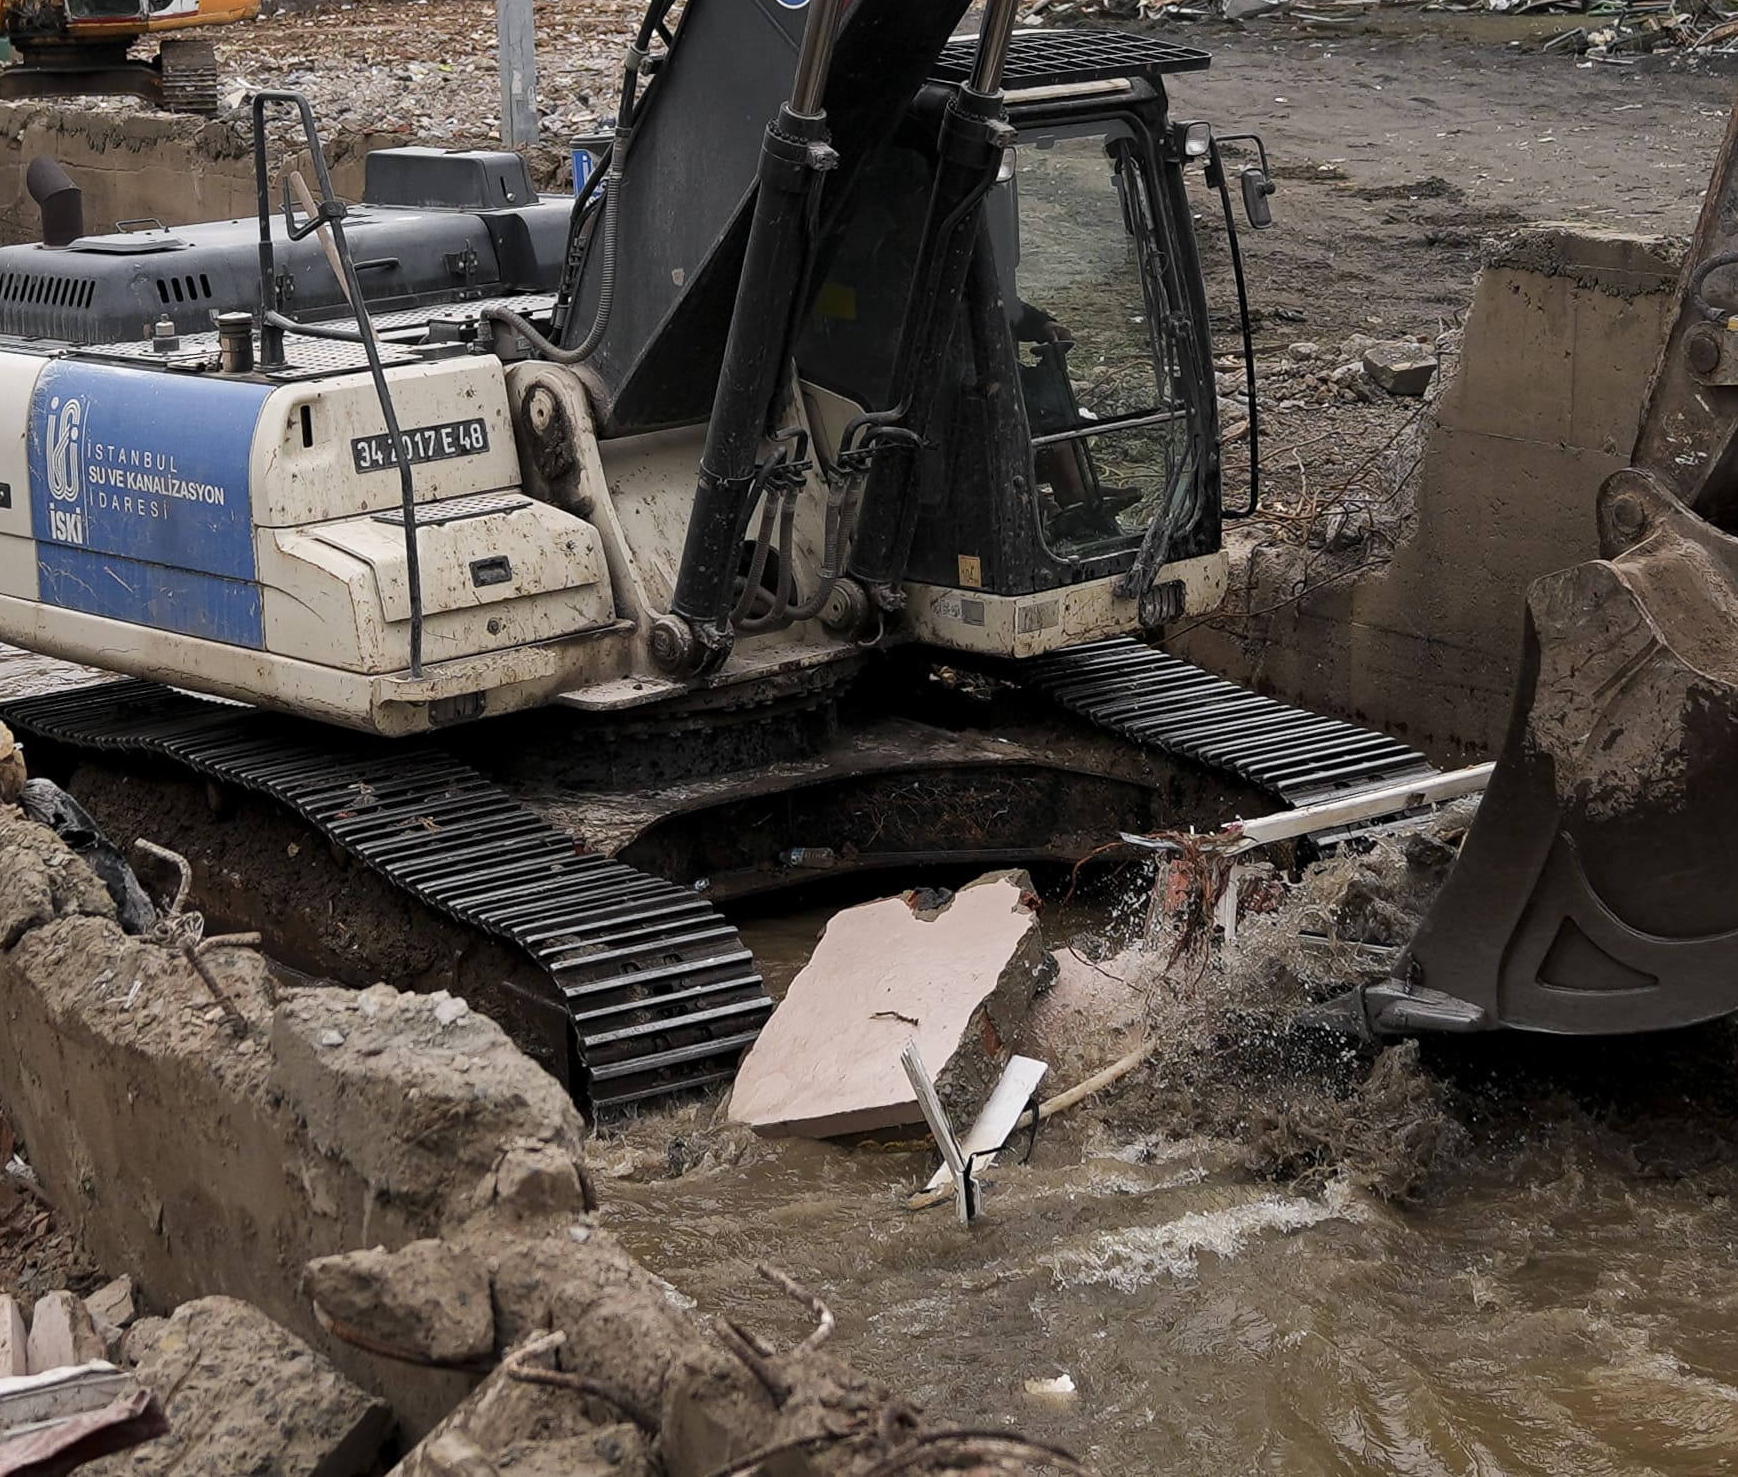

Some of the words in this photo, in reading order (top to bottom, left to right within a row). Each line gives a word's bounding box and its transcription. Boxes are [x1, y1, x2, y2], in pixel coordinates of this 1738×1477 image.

[87, 439, 177, 473] İSTANBUL
[357, 440, 383, 467] 34
[440, 427, 455, 454] E
[459, 423, 484, 450] 48
[88, 465, 105, 484] SU
[107, 469, 125, 488] VE
[127, 471, 225, 506] KANALİZASYON
[49, 502, 84, 544] İSKİ
